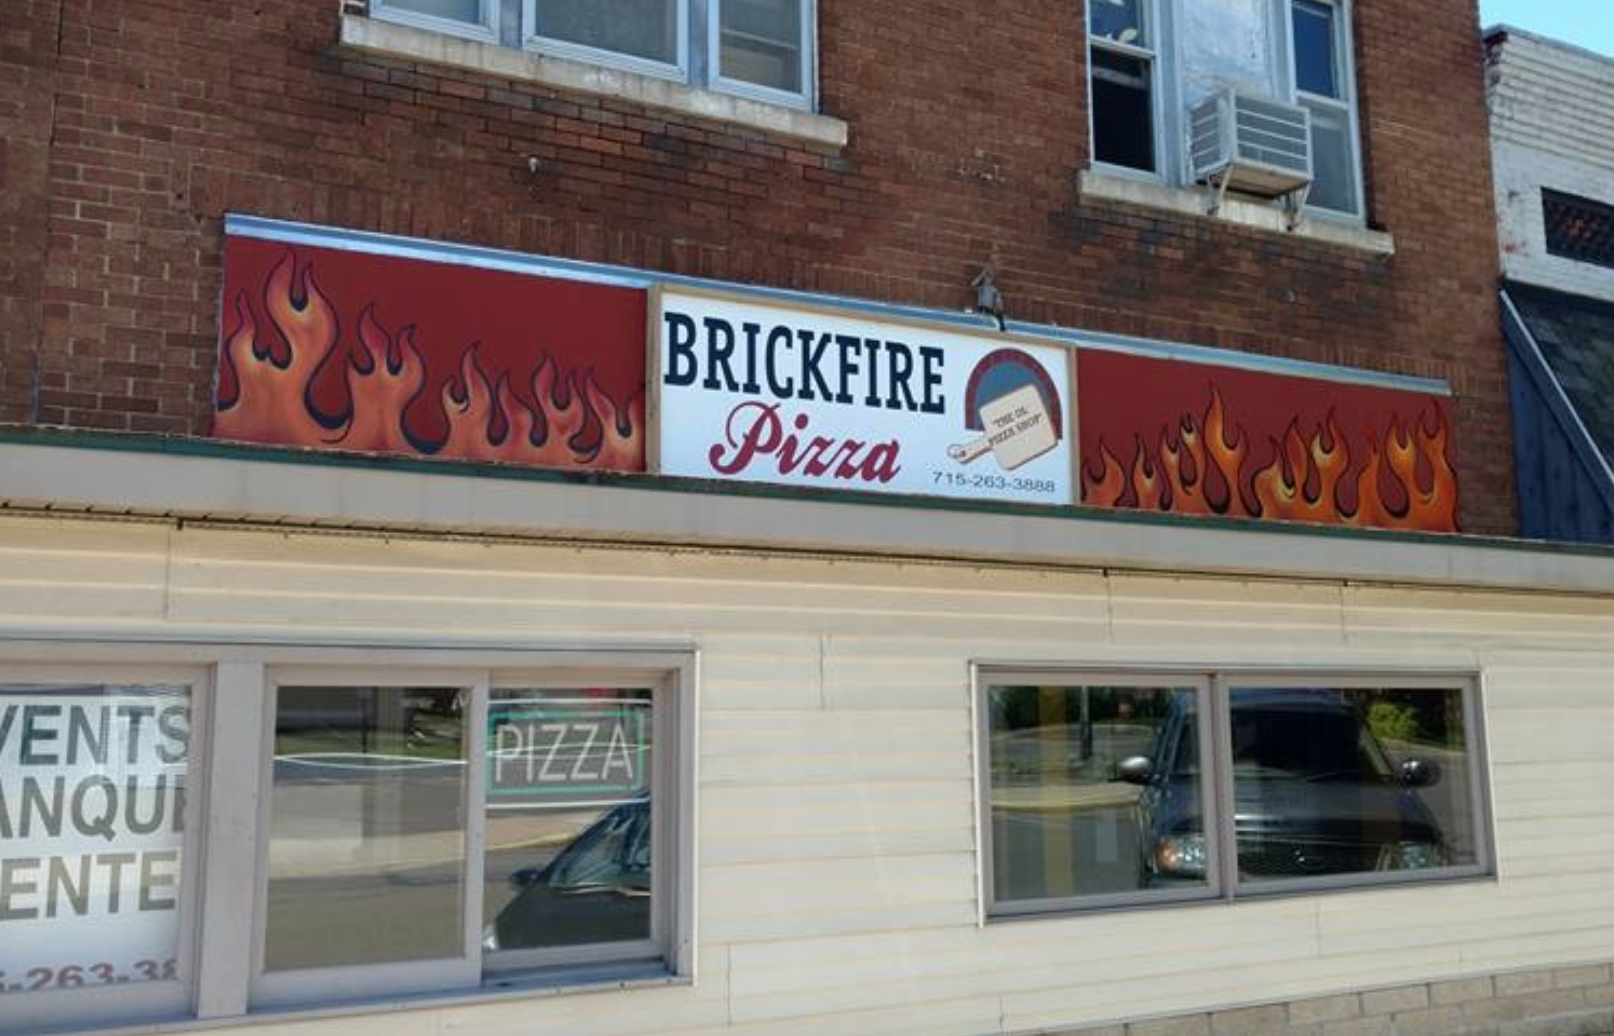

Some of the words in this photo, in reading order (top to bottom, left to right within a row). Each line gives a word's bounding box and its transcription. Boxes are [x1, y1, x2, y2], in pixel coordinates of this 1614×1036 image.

[663, 311, 945, 415] BRICKFIRE
[709, 400, 901, 484] Pizza
[988, 428, 1016, 447] PIZZA
[932, 471, 1056, 493] 715-263-3888
[495, 722, 633, 783] PIZZA
